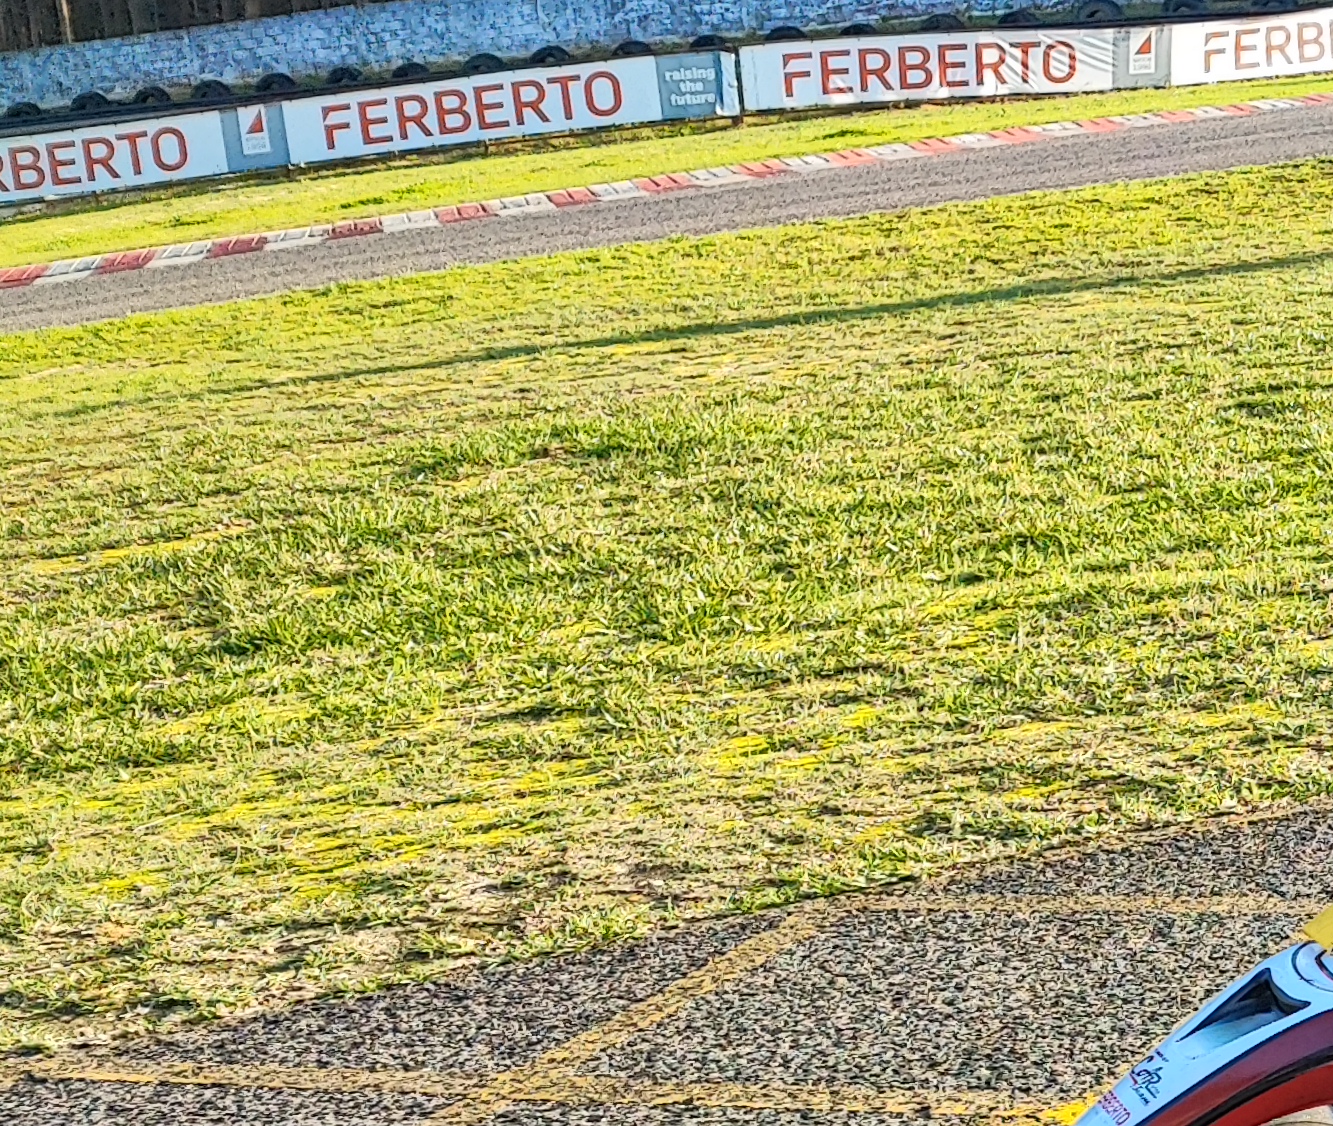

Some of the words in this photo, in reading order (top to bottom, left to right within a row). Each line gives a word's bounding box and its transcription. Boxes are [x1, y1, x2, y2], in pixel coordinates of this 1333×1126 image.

[664, 67, 716, 82] raising
[781, 40, 1077, 98] FERBERTO
[679, 80, 704, 93] the
[670, 93, 716, 106] future
[321, 70, 622, 150] FERBERTO
